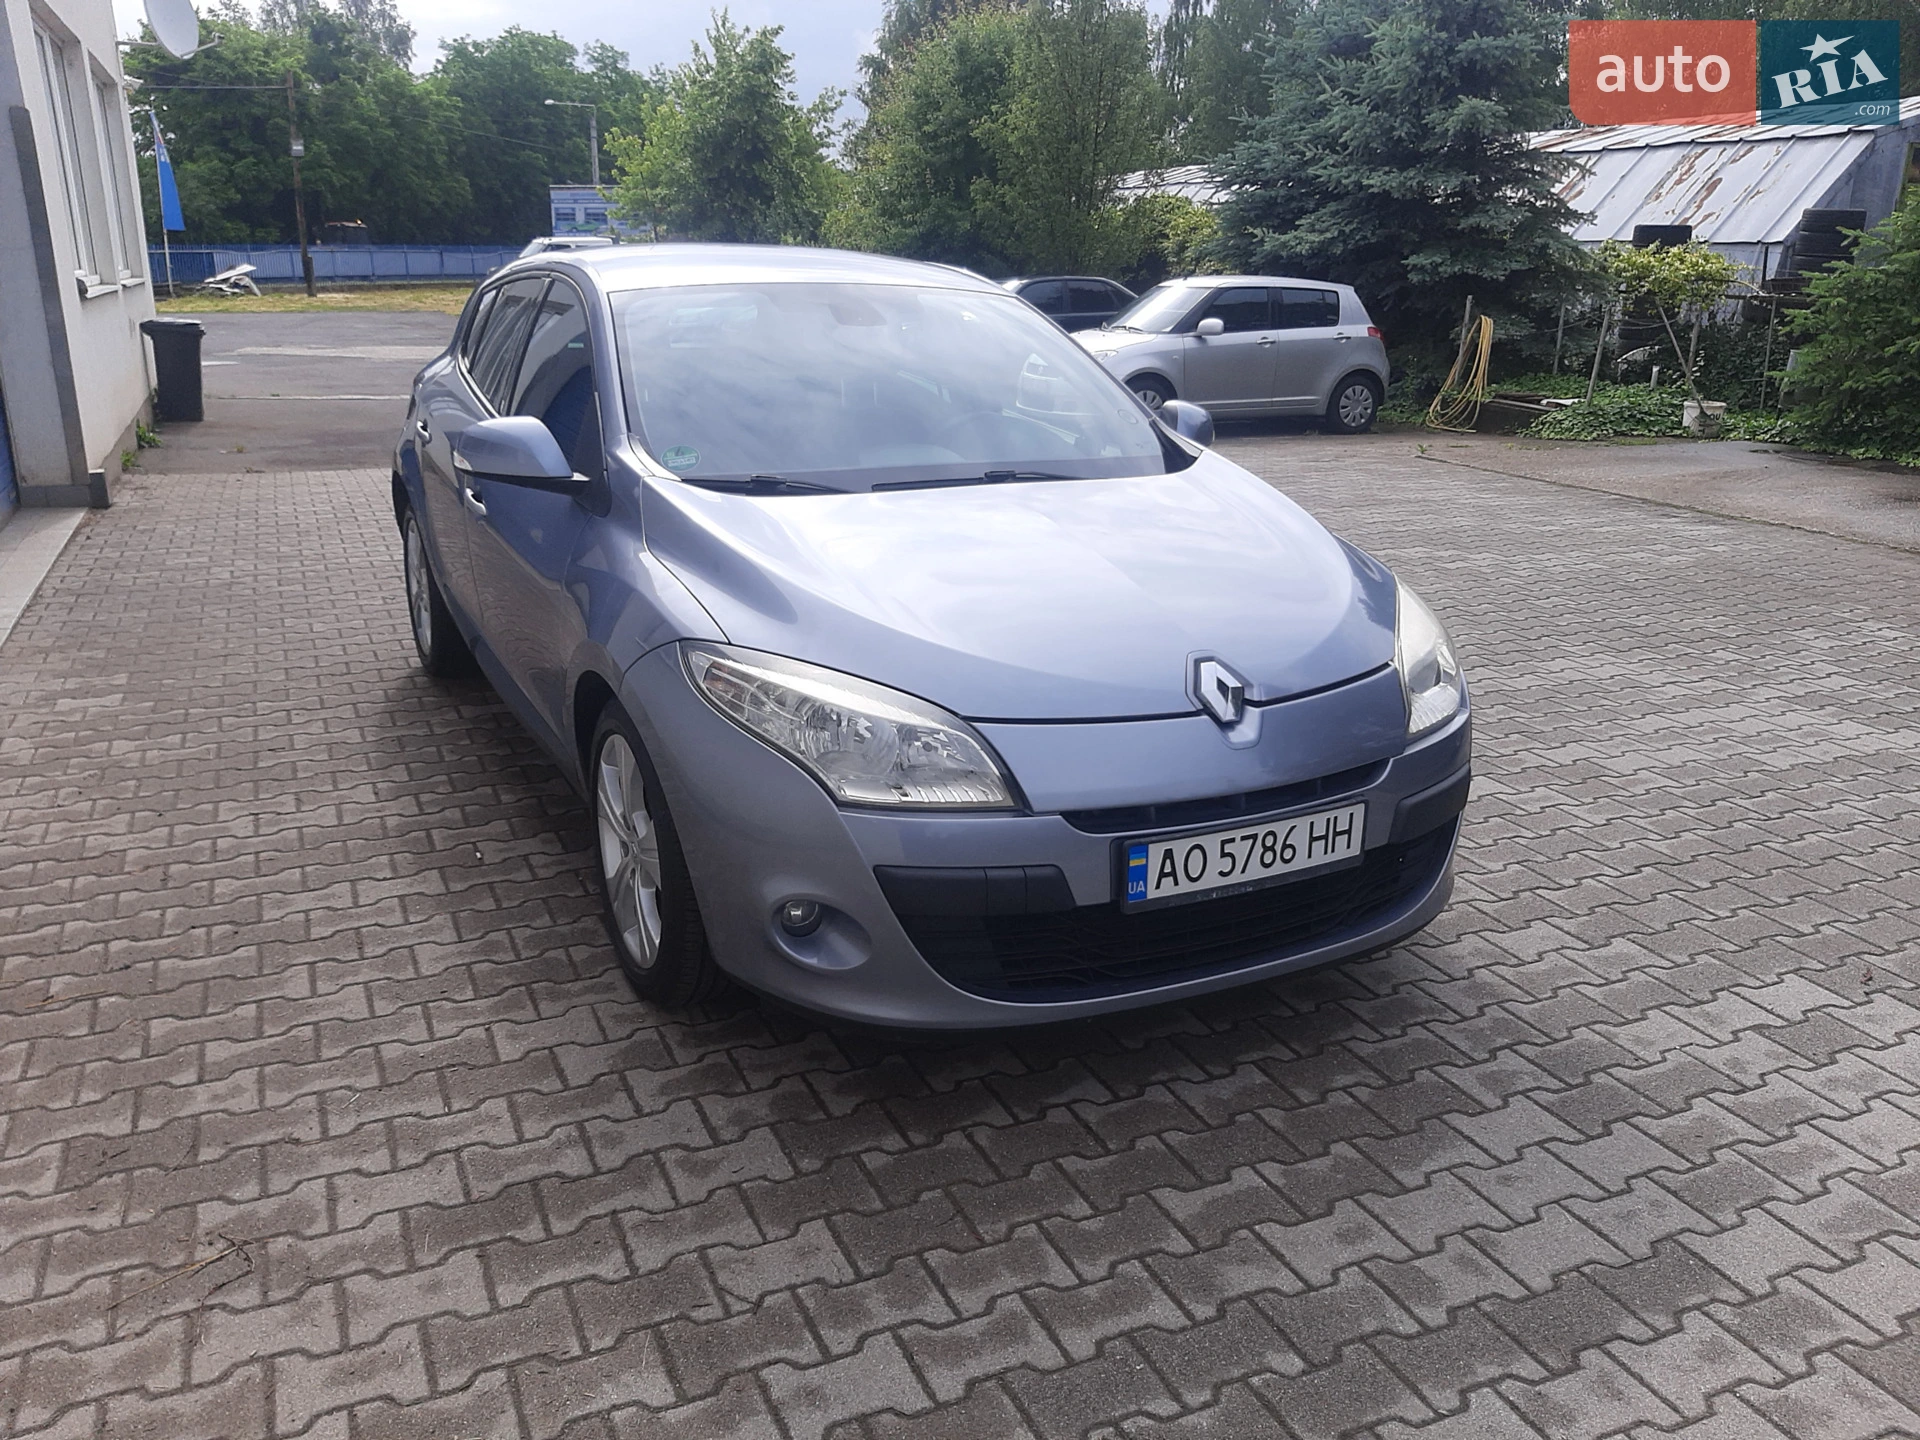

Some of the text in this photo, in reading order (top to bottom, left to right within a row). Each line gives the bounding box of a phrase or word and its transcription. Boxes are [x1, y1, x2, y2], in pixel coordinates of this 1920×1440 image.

[1154, 811, 1354, 890] AO 5786 HH
[1128, 880, 1146, 894] UA
